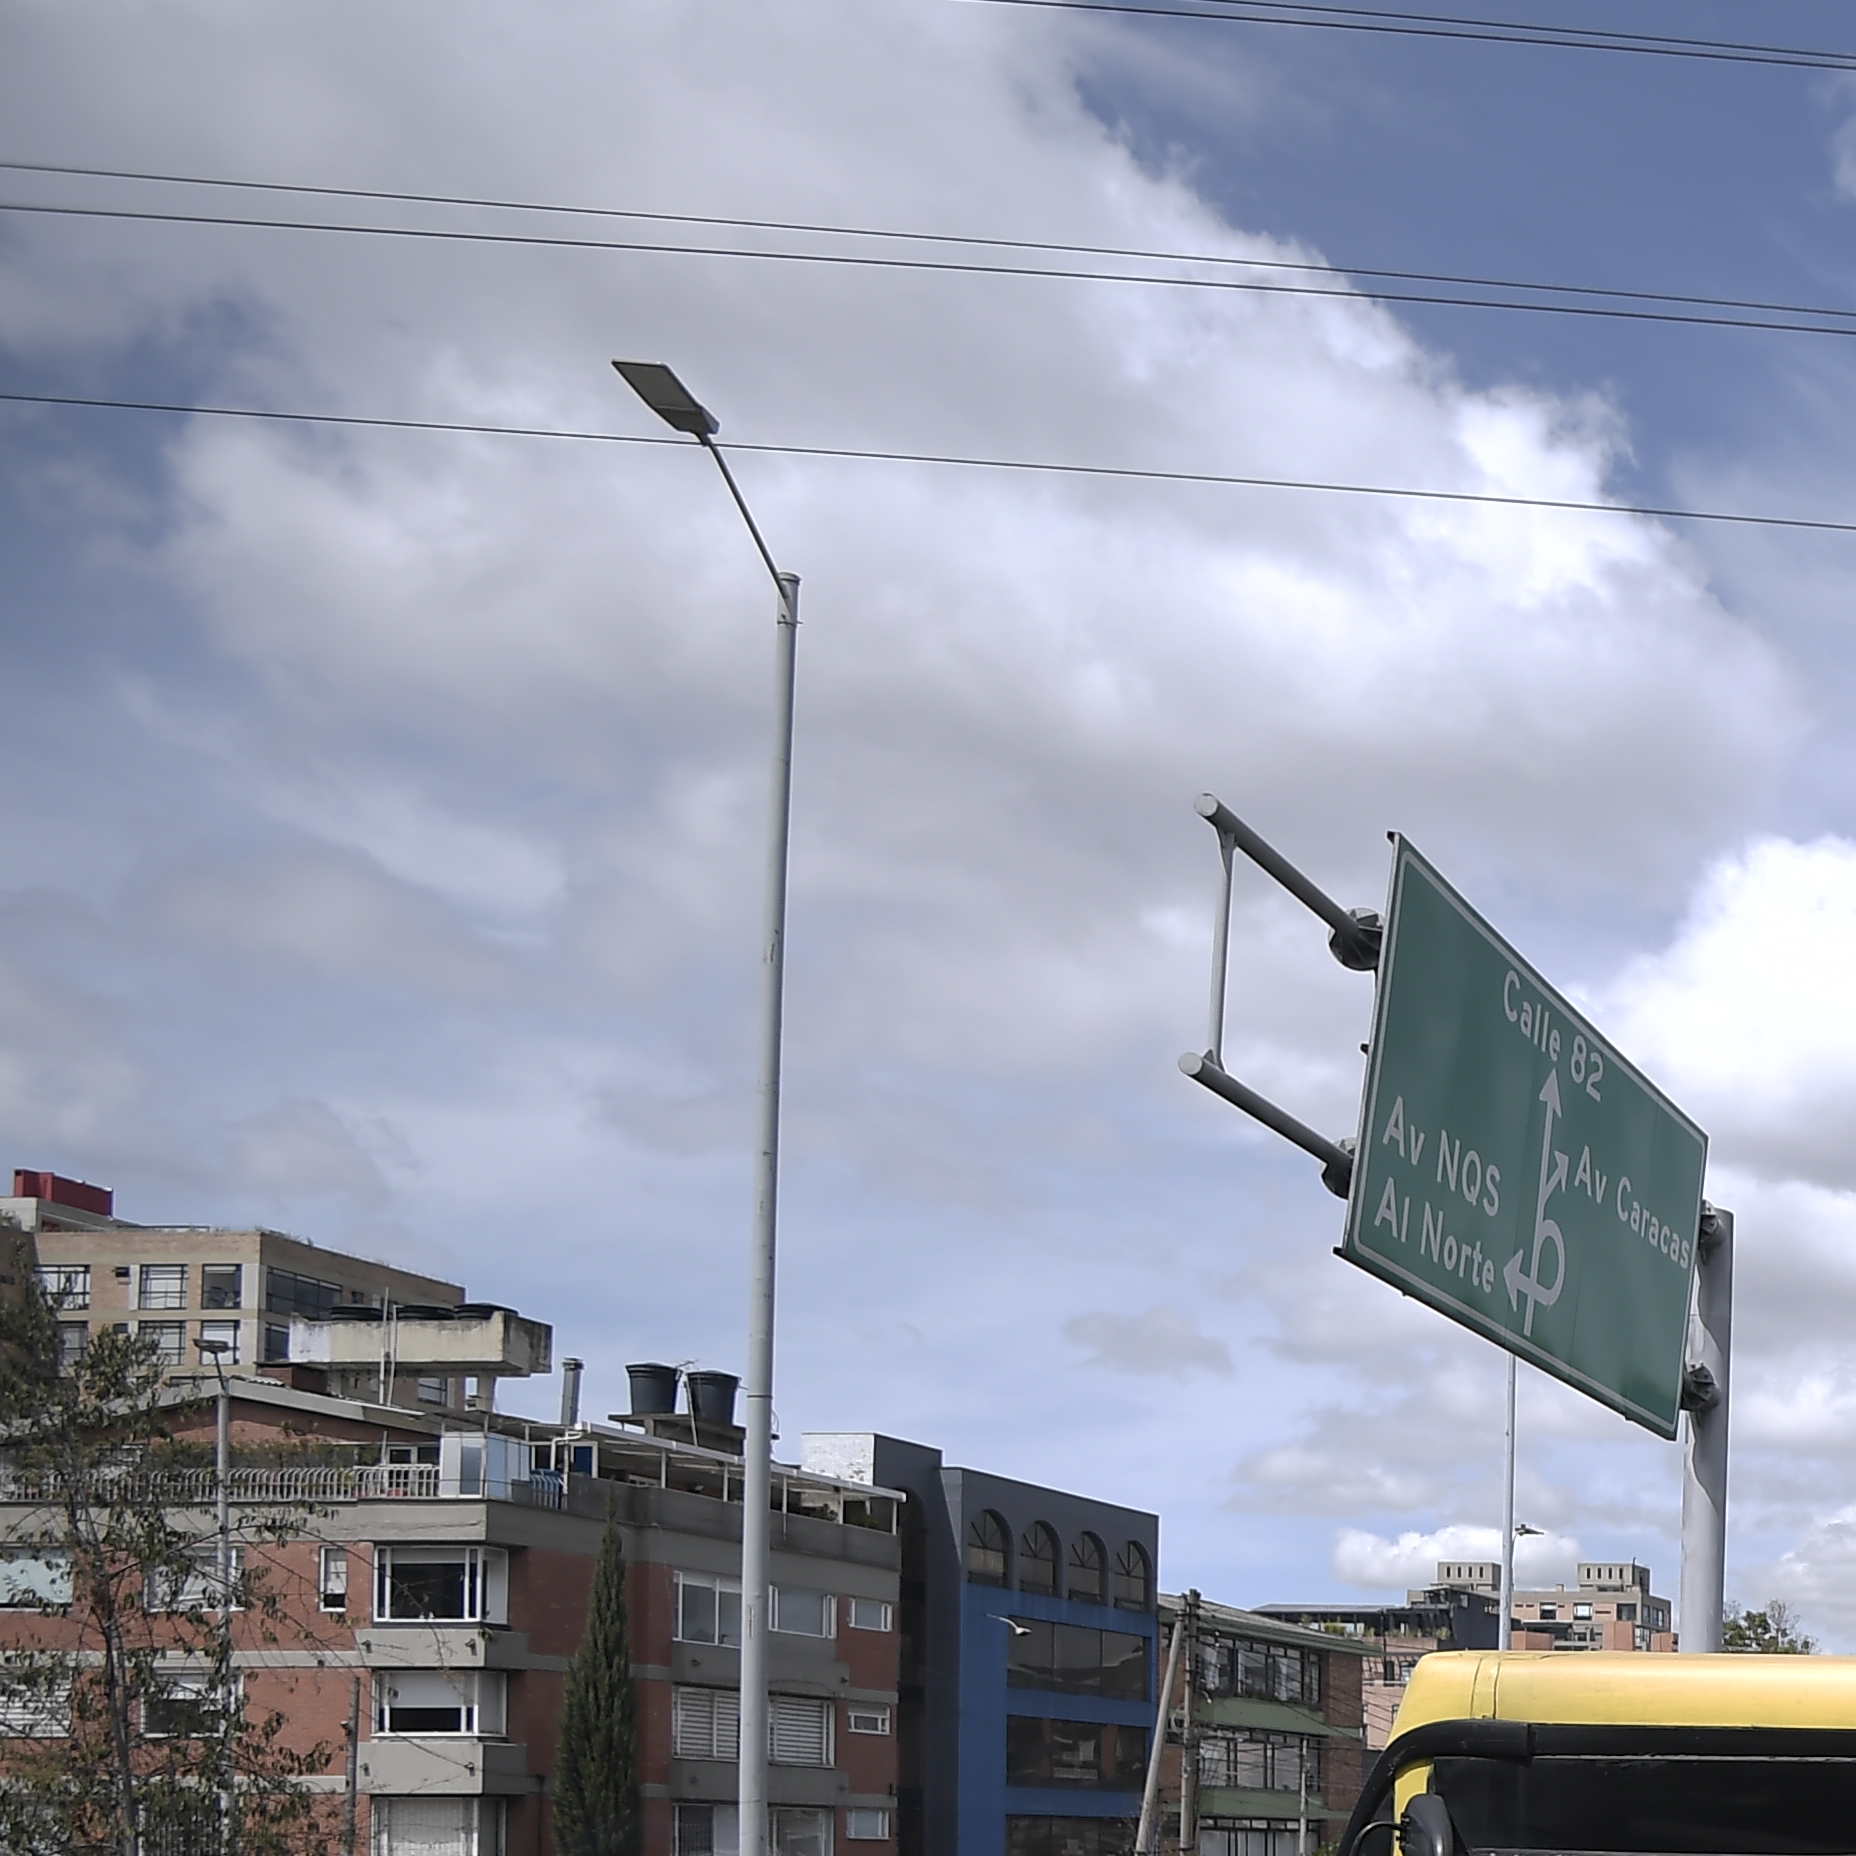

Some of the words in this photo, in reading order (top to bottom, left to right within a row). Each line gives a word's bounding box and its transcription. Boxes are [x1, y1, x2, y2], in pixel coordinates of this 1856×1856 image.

[1503, 969, 1561, 1062] Calle
[1571, 1035, 1604, 1102] 82
[1382, 1095, 1426, 1166] Av
[1437, 1129, 1502, 1217] NQS
[1574, 1145, 1608, 1204] Av
[1617, 1175, 1691, 1269] Caracas
[1374, 1176, 1411, 1244] Al
[1420, 1201, 1495, 1294] Norte
